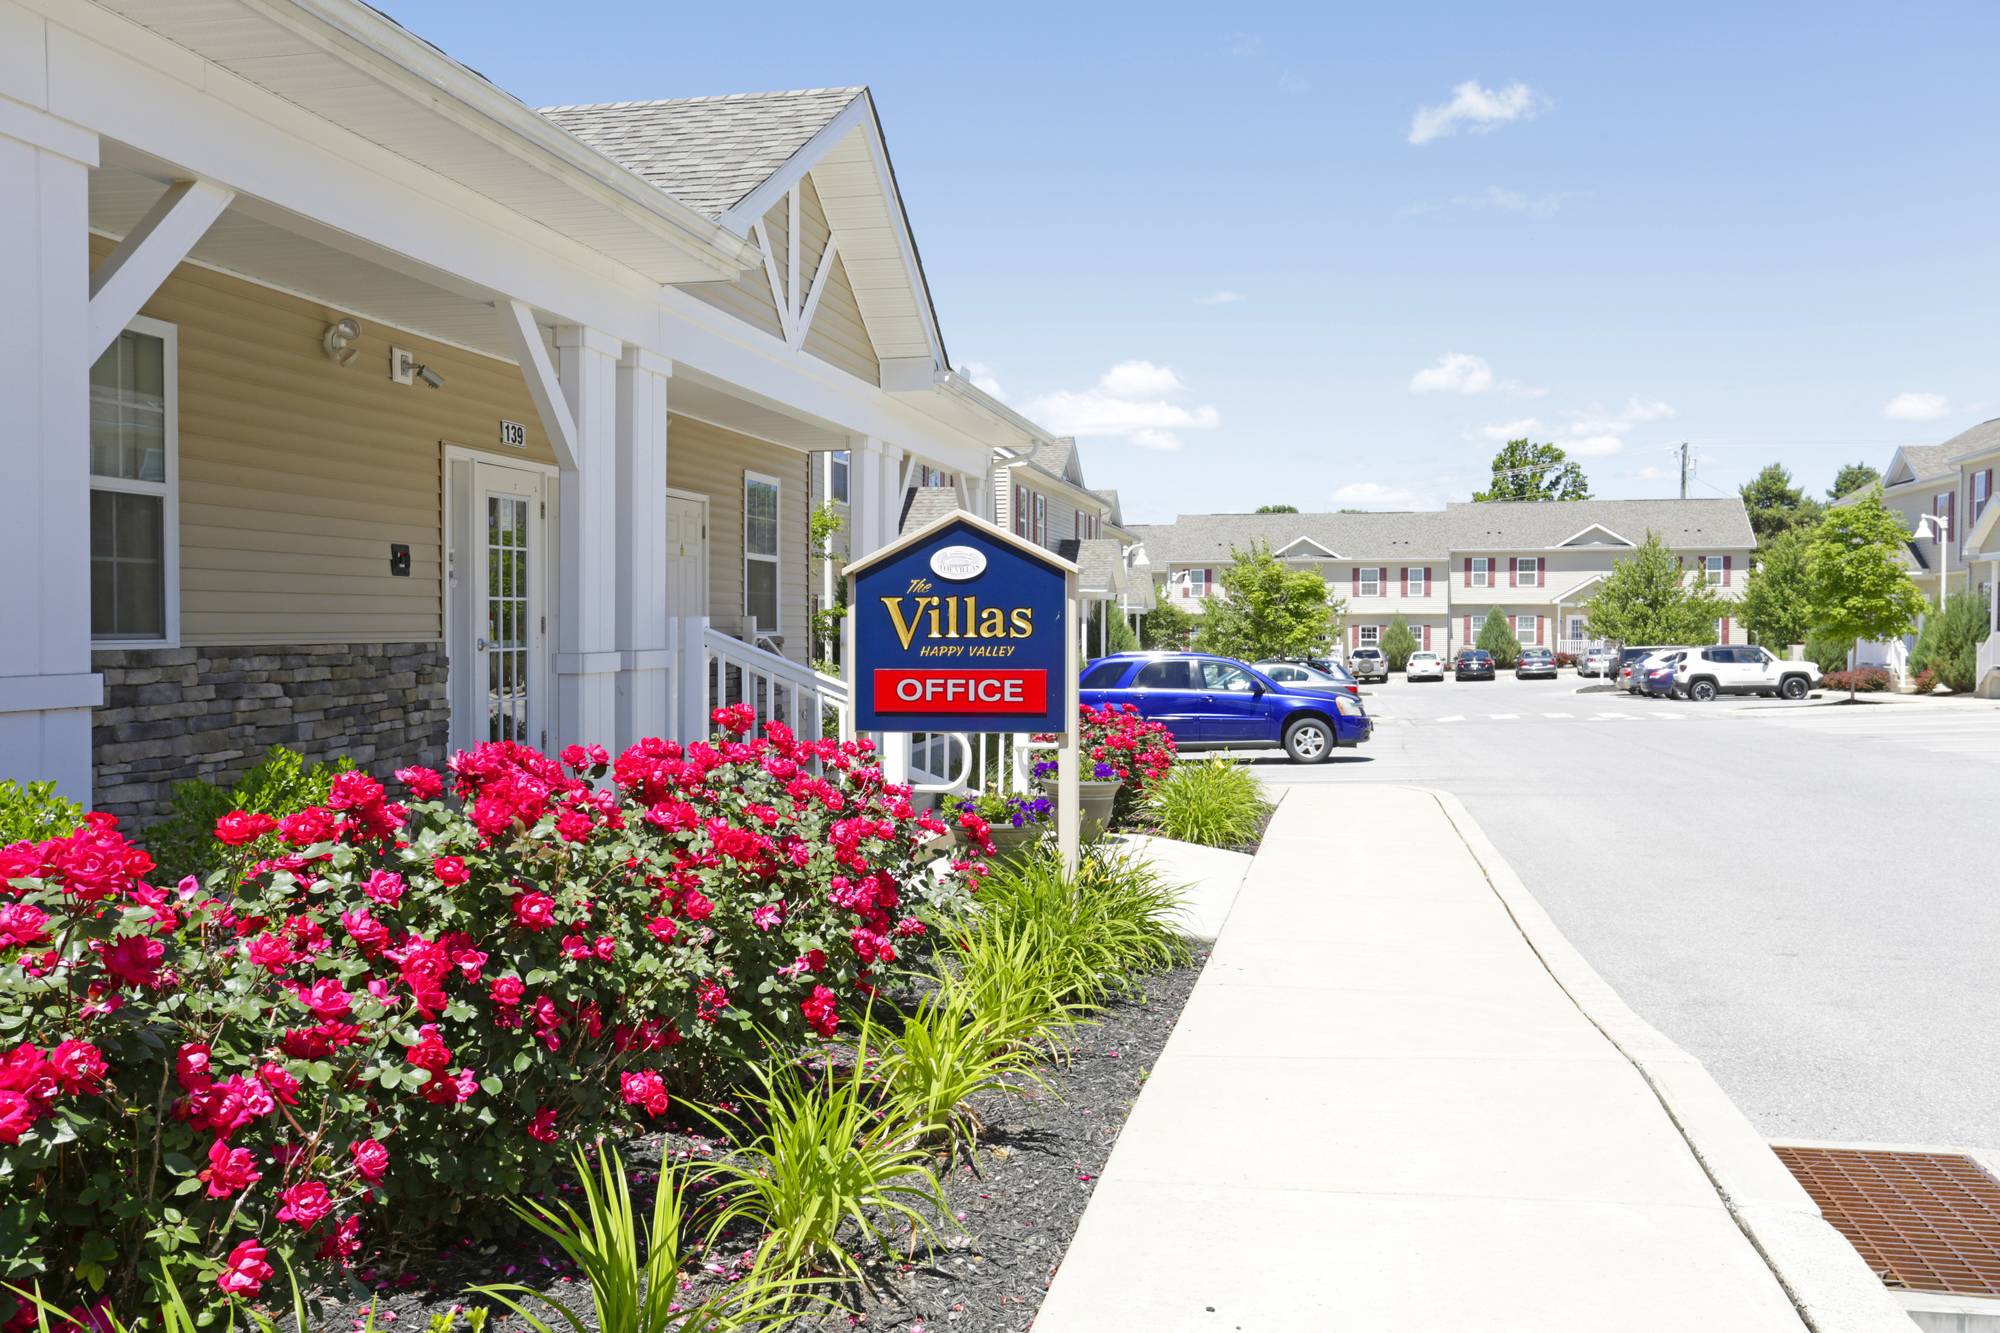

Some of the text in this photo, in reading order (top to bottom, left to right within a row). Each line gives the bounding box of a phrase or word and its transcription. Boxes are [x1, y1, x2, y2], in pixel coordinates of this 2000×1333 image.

[505, 424, 523, 444] 139
[907, 578, 932, 594] The
[880, 596, 1033, 651] Villas
[920, 646, 1015, 657] HAPPY VALLEY
[896, 679, 1024, 702] OFFICE
